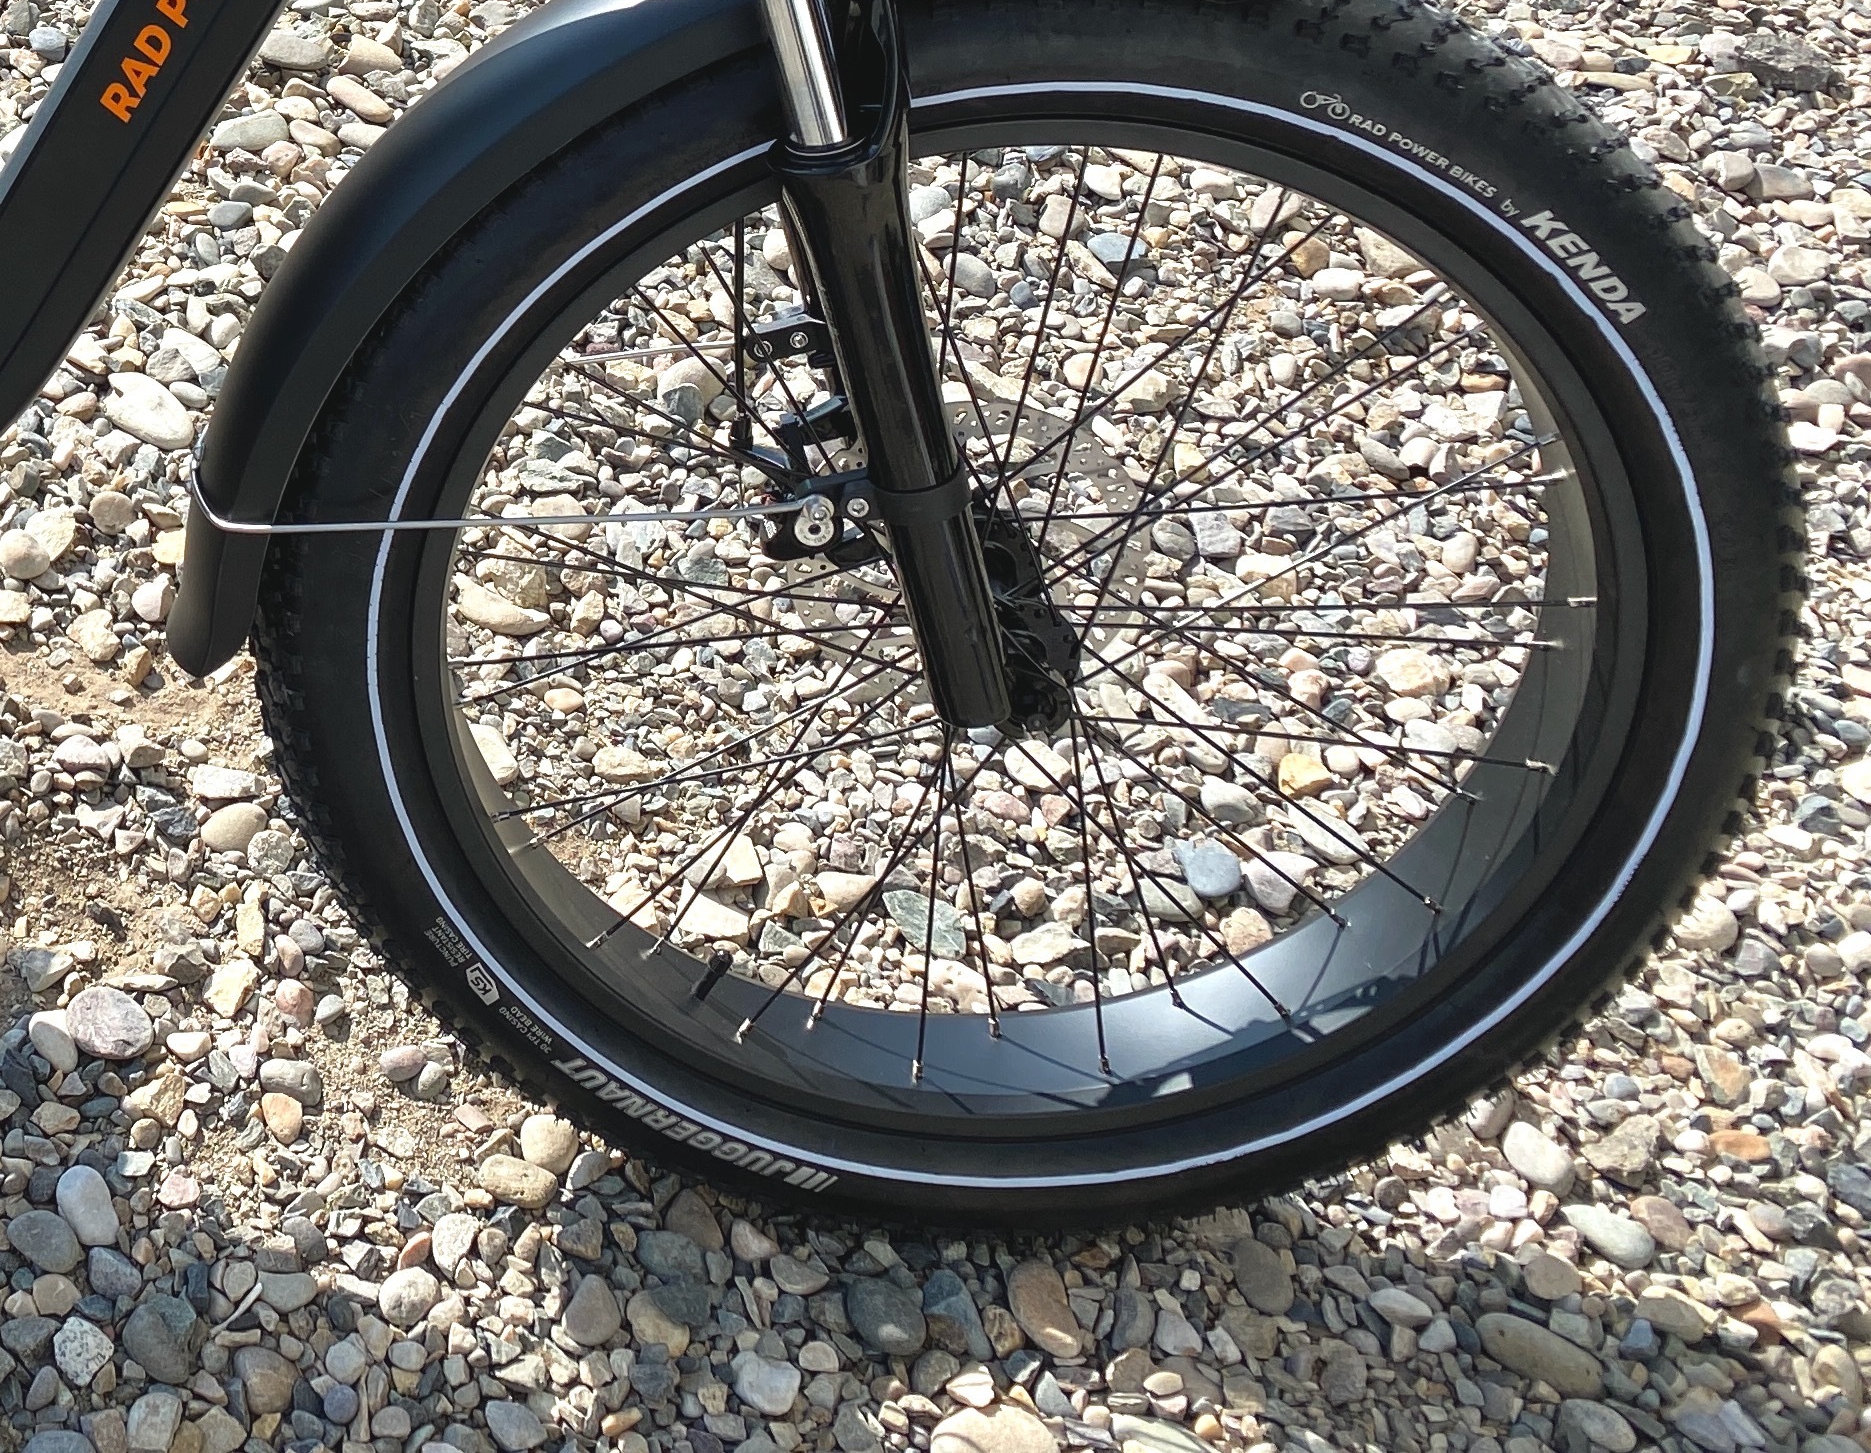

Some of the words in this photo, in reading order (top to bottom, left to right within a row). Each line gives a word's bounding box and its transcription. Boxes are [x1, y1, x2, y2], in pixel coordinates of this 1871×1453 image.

[100, 23, 172, 123] RAD
[1348, 113, 1386, 138] RAD
[1388, 131, 1450, 170] POWER
[1449, 165, 1499, 199] BIKES
[1500, 198, 1521, 218] by
[1521, 209, 1647, 325] KENDA
[470, 976, 492, 995] KS
[551, 1057, 798, 1178] JUGGERNAUT
